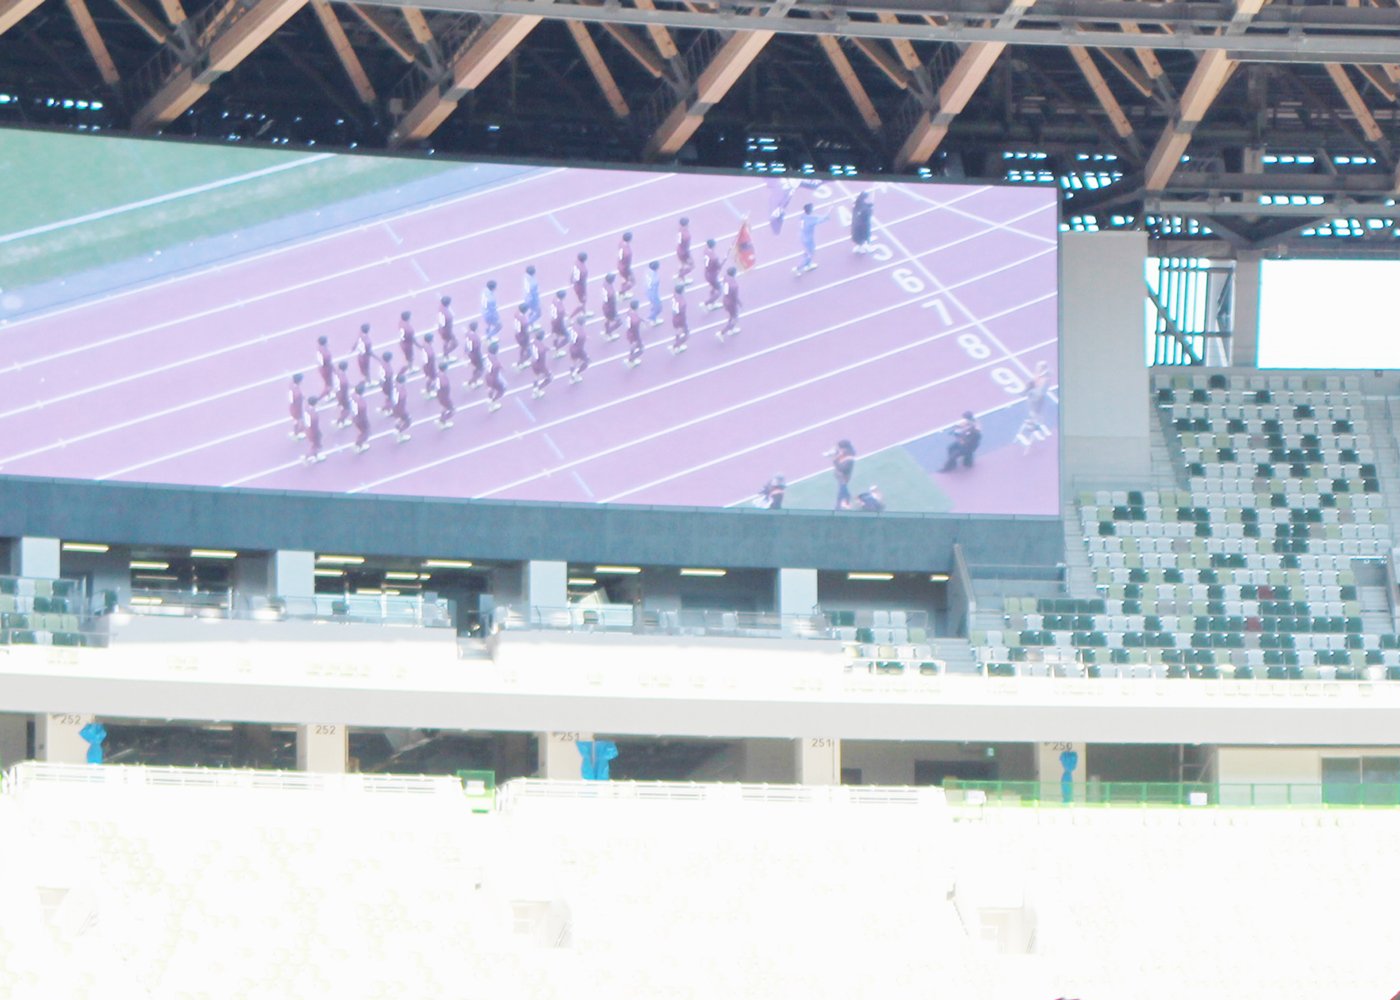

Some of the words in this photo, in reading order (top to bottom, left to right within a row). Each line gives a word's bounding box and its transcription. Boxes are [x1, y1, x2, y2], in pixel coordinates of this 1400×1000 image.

[957, 333, 991, 359] 8
[60, 714, 82, 726] 252
[315, 725, 336, 735] 252
[811, 738, 832, 748] 251
